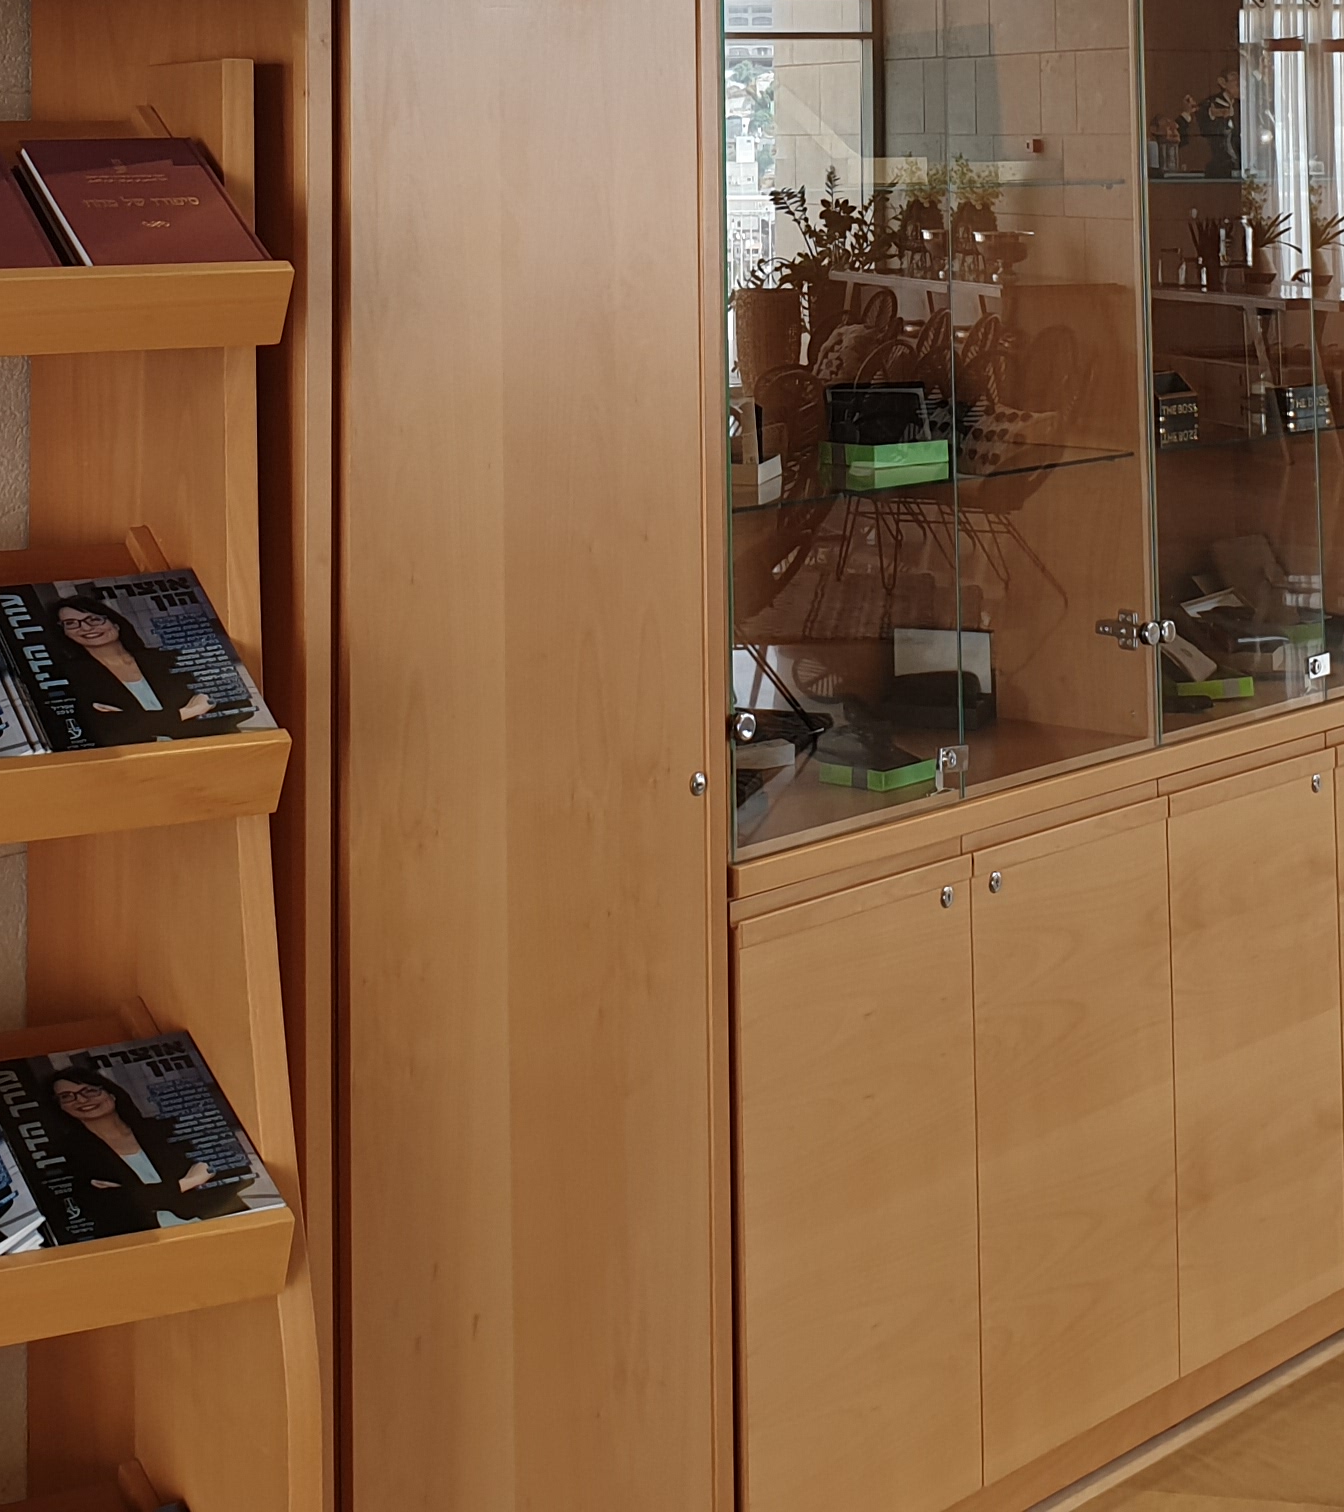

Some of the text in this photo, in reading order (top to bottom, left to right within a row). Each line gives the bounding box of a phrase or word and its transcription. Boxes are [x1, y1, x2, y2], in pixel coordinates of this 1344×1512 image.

[1161, 405, 1177, 415] THE
[150, 590, 199, 612] הון
[22, 644, 69, 690] הדין
[145, 1054, 195, 1077] הון
[18, 1121, 67, 1170] הדין
